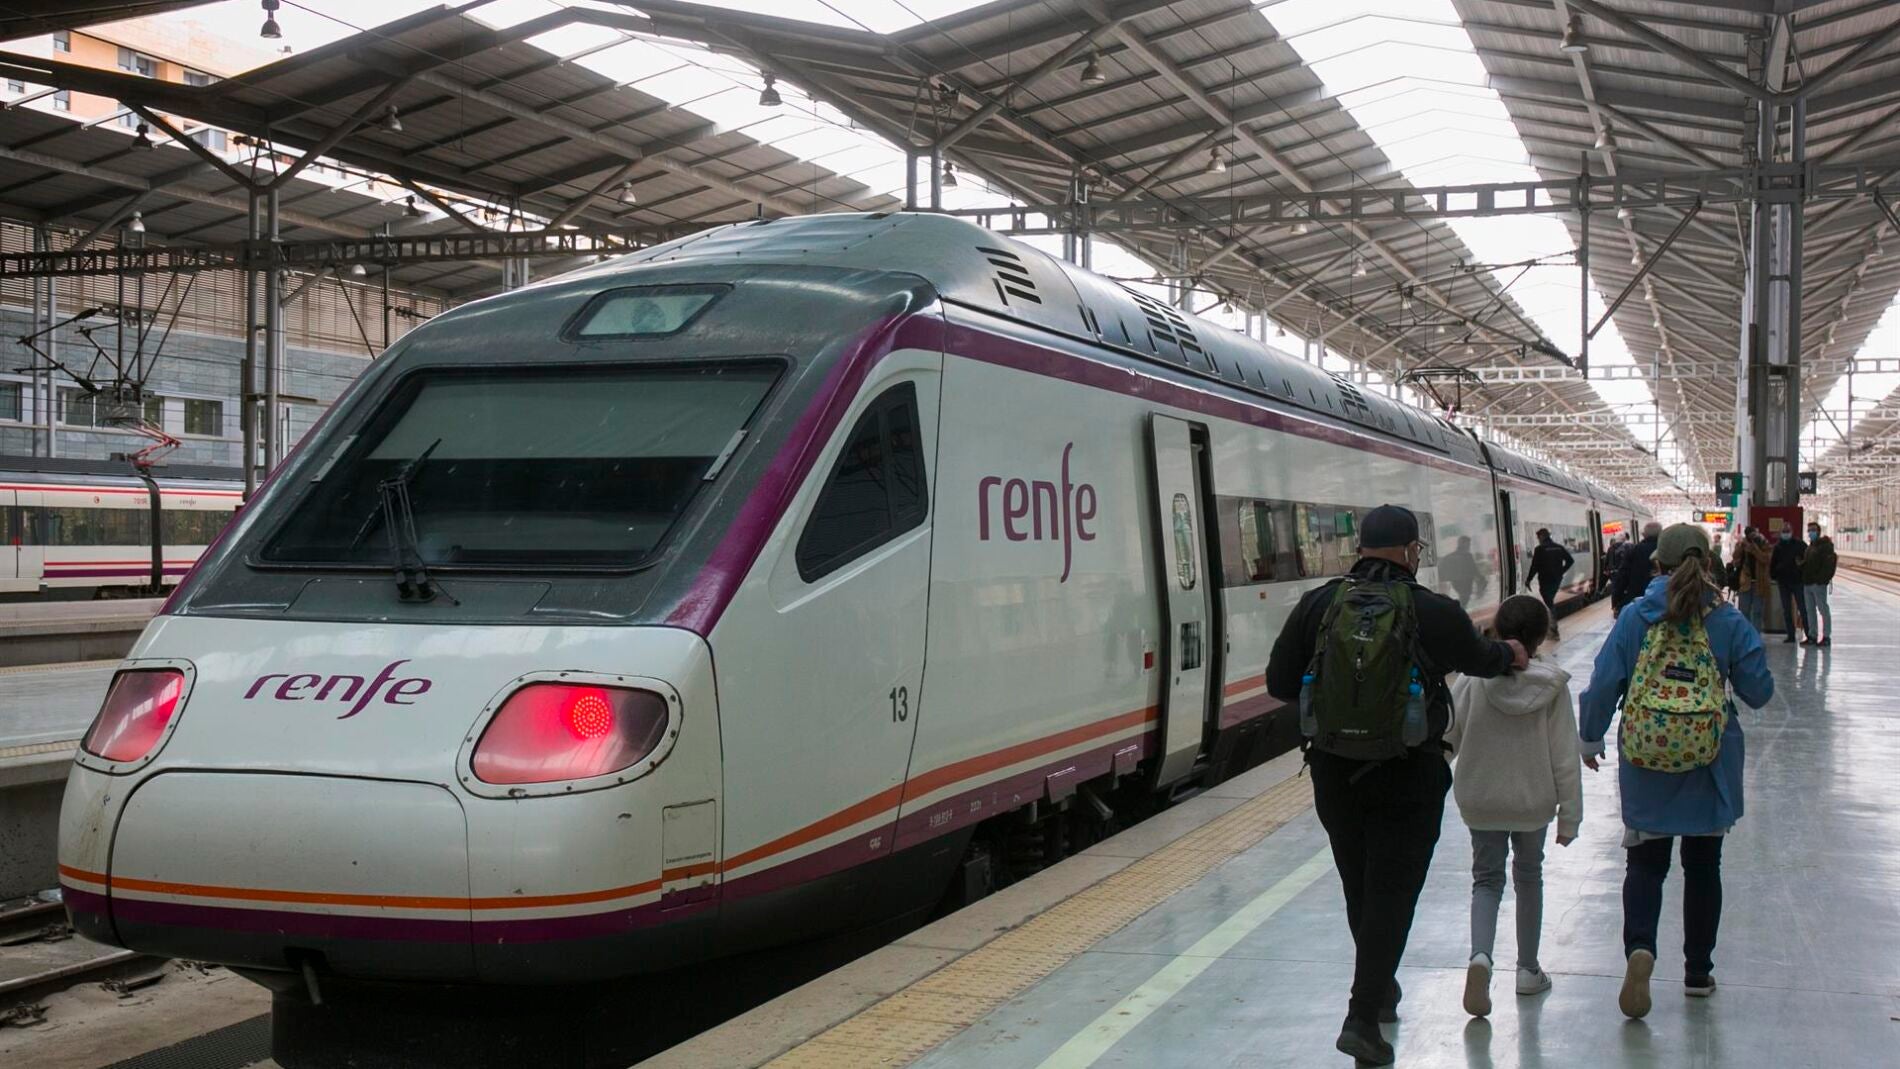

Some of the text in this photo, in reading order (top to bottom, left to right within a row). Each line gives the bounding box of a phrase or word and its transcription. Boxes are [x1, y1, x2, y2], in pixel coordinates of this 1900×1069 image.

[980, 442, 1096, 582] renfe
[245, 660, 431, 719] renfe
[889, 686, 908, 722] 13
